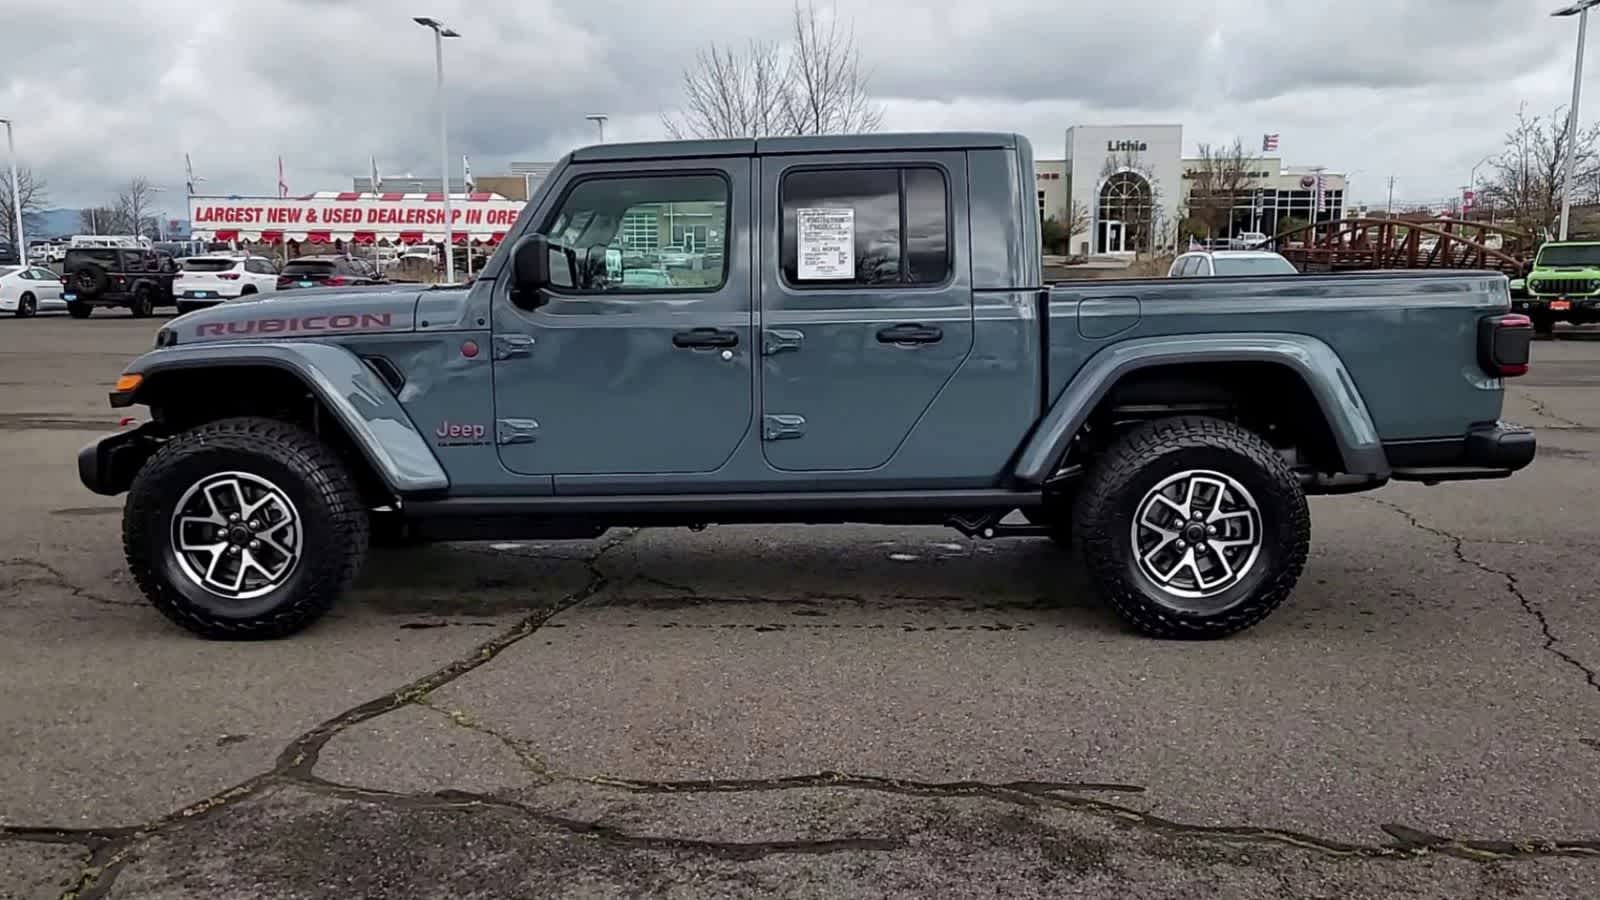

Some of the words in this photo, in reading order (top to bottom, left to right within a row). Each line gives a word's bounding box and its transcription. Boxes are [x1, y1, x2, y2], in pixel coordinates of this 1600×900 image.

[1107, 140, 1147, 151] Lithia
[195, 207, 263, 223] LARGEST
[267, 207, 302, 223] NEW
[306, 208, 318, 223] &
[322, 207, 363, 224] USED
[367, 208, 462, 225] DEALERSHP
[465, 209, 482, 225] IN
[486, 209, 521, 225] ORE
[197, 313, 391, 337] RUBICON
[436, 420, 485, 440] Jeep
